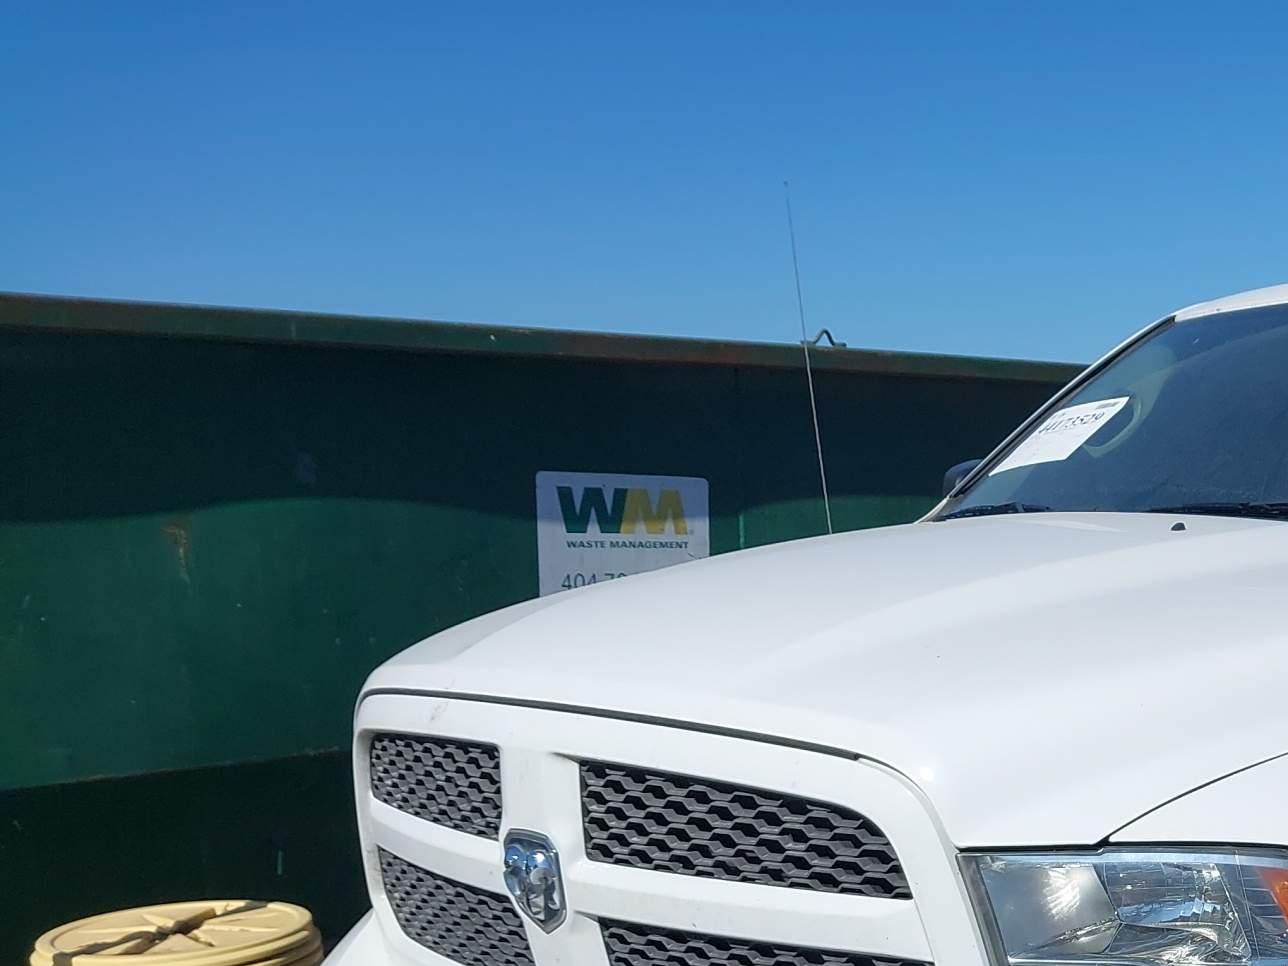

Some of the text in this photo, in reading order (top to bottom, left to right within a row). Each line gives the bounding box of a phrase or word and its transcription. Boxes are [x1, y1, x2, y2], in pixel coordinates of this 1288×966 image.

[556, 486, 688, 535] WM
[566, 540, 689, 549] WASTE MANAGEMENT
